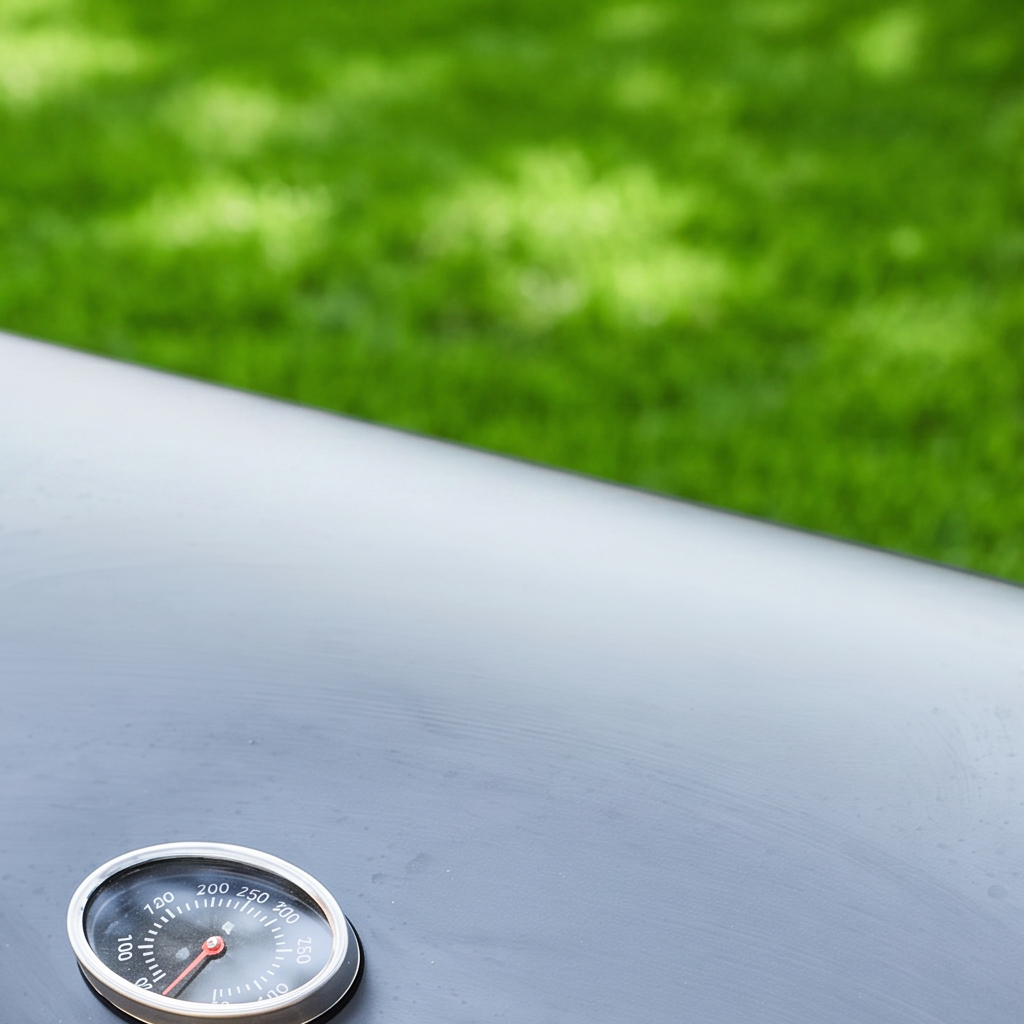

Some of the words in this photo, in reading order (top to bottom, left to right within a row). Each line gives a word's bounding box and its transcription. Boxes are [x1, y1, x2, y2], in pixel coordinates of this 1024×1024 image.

[196, 883, 229, 896] 200
[236, 886, 270, 904] 250
[117, 934, 133, 961] 100
